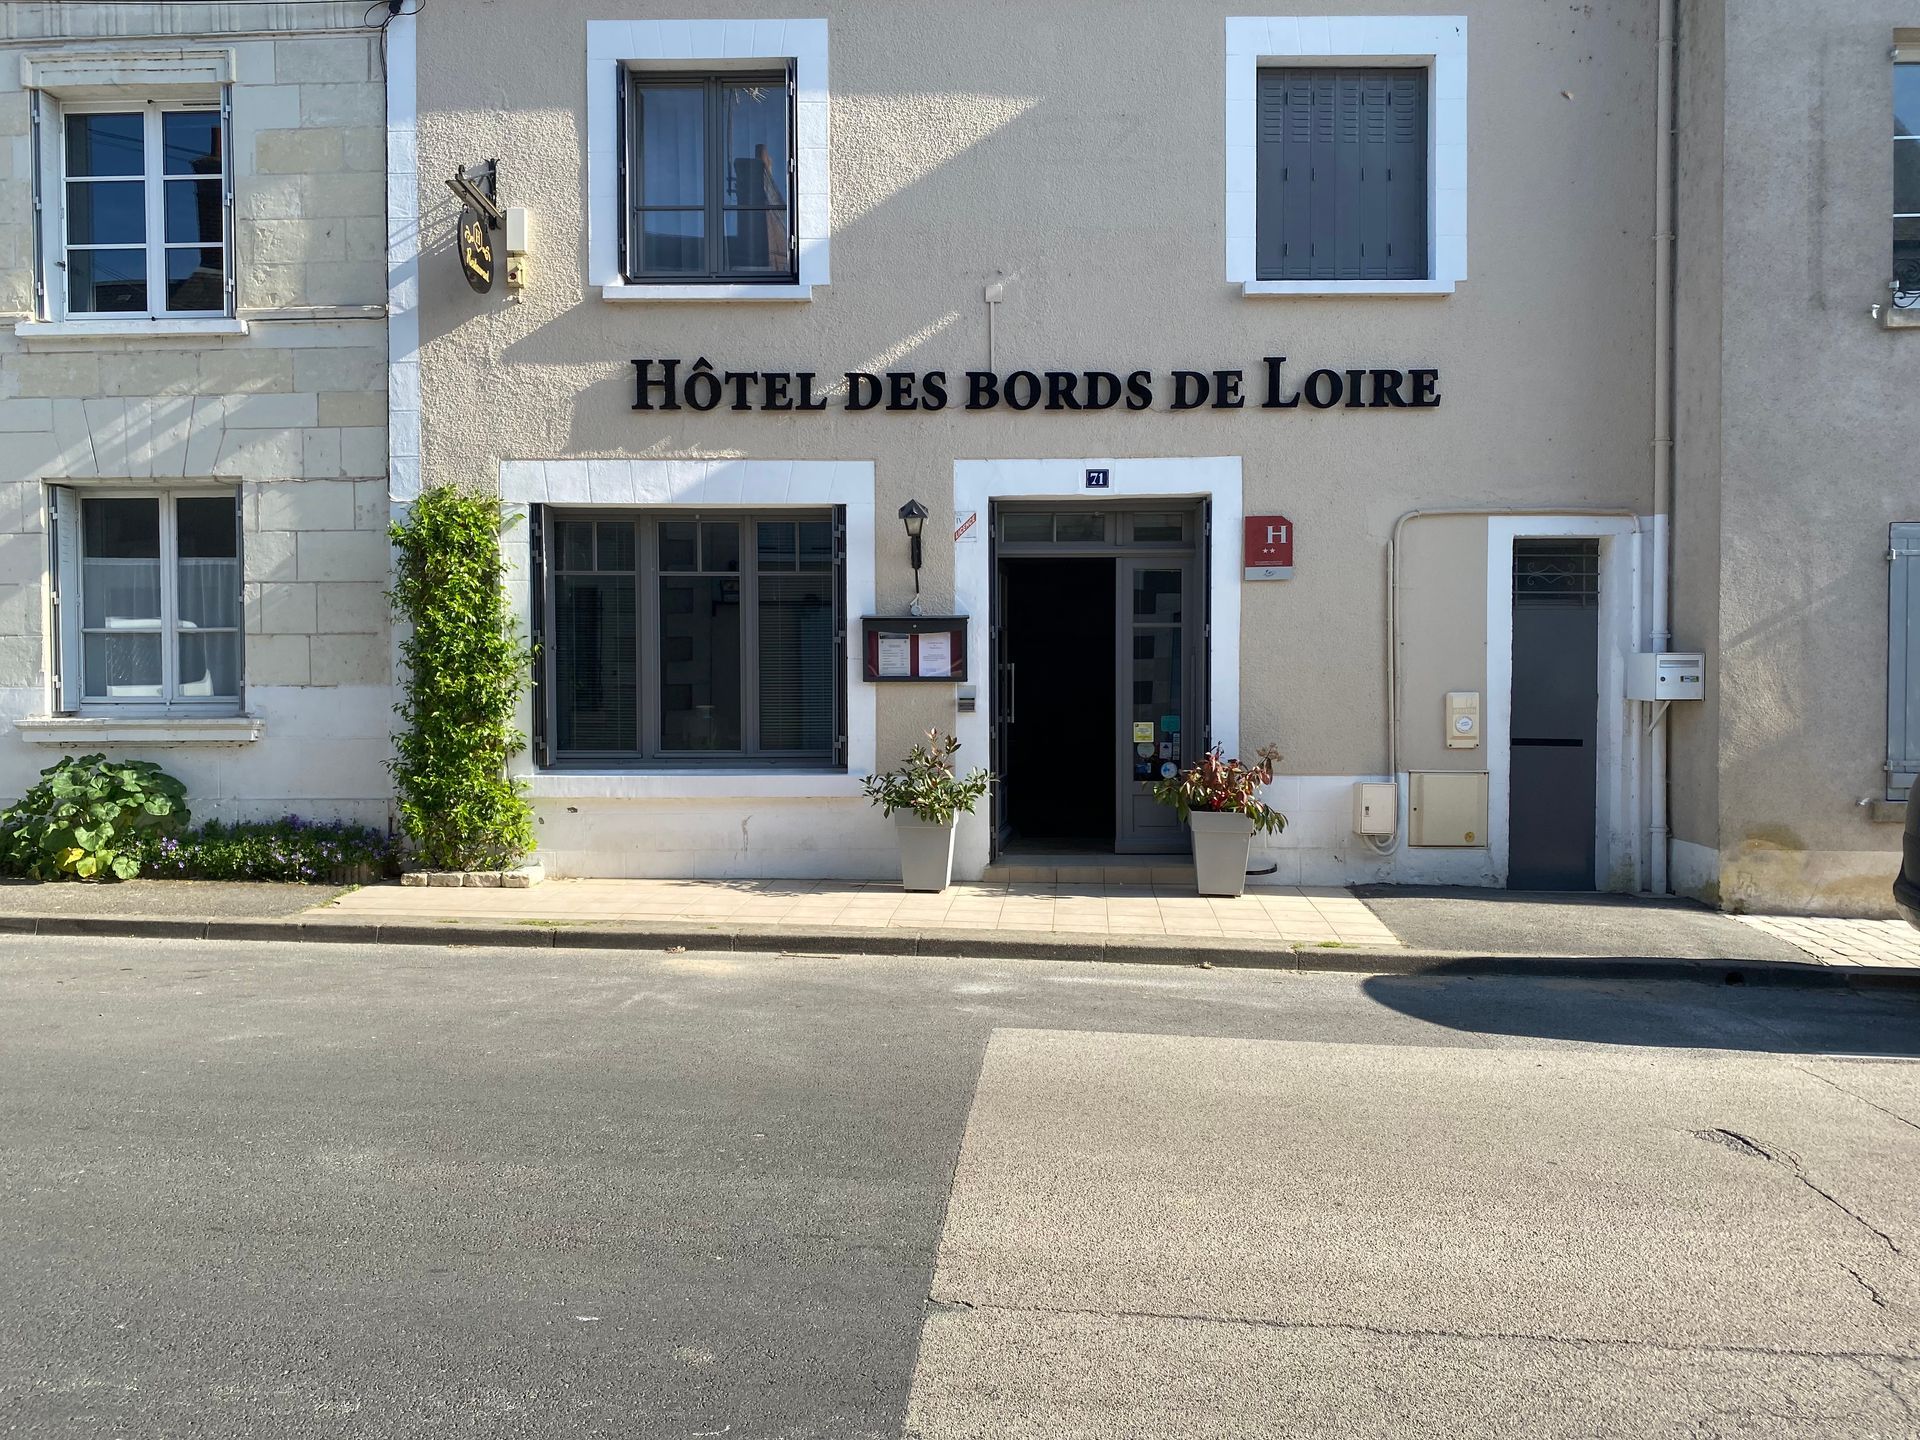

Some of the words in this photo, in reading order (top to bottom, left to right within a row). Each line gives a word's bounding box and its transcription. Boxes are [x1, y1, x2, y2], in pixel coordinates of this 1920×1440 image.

[631, 357, 827, 411] HÔTEL
[844, 371, 948, 411] DES
[965, 370, 1153, 410] BORDS
[1170, 370, 1246, 410] DE
[1261, 356, 1442, 409] LOIRE
[1090, 472, 1104, 485] 71
[1266, 525, 1288, 544] H
